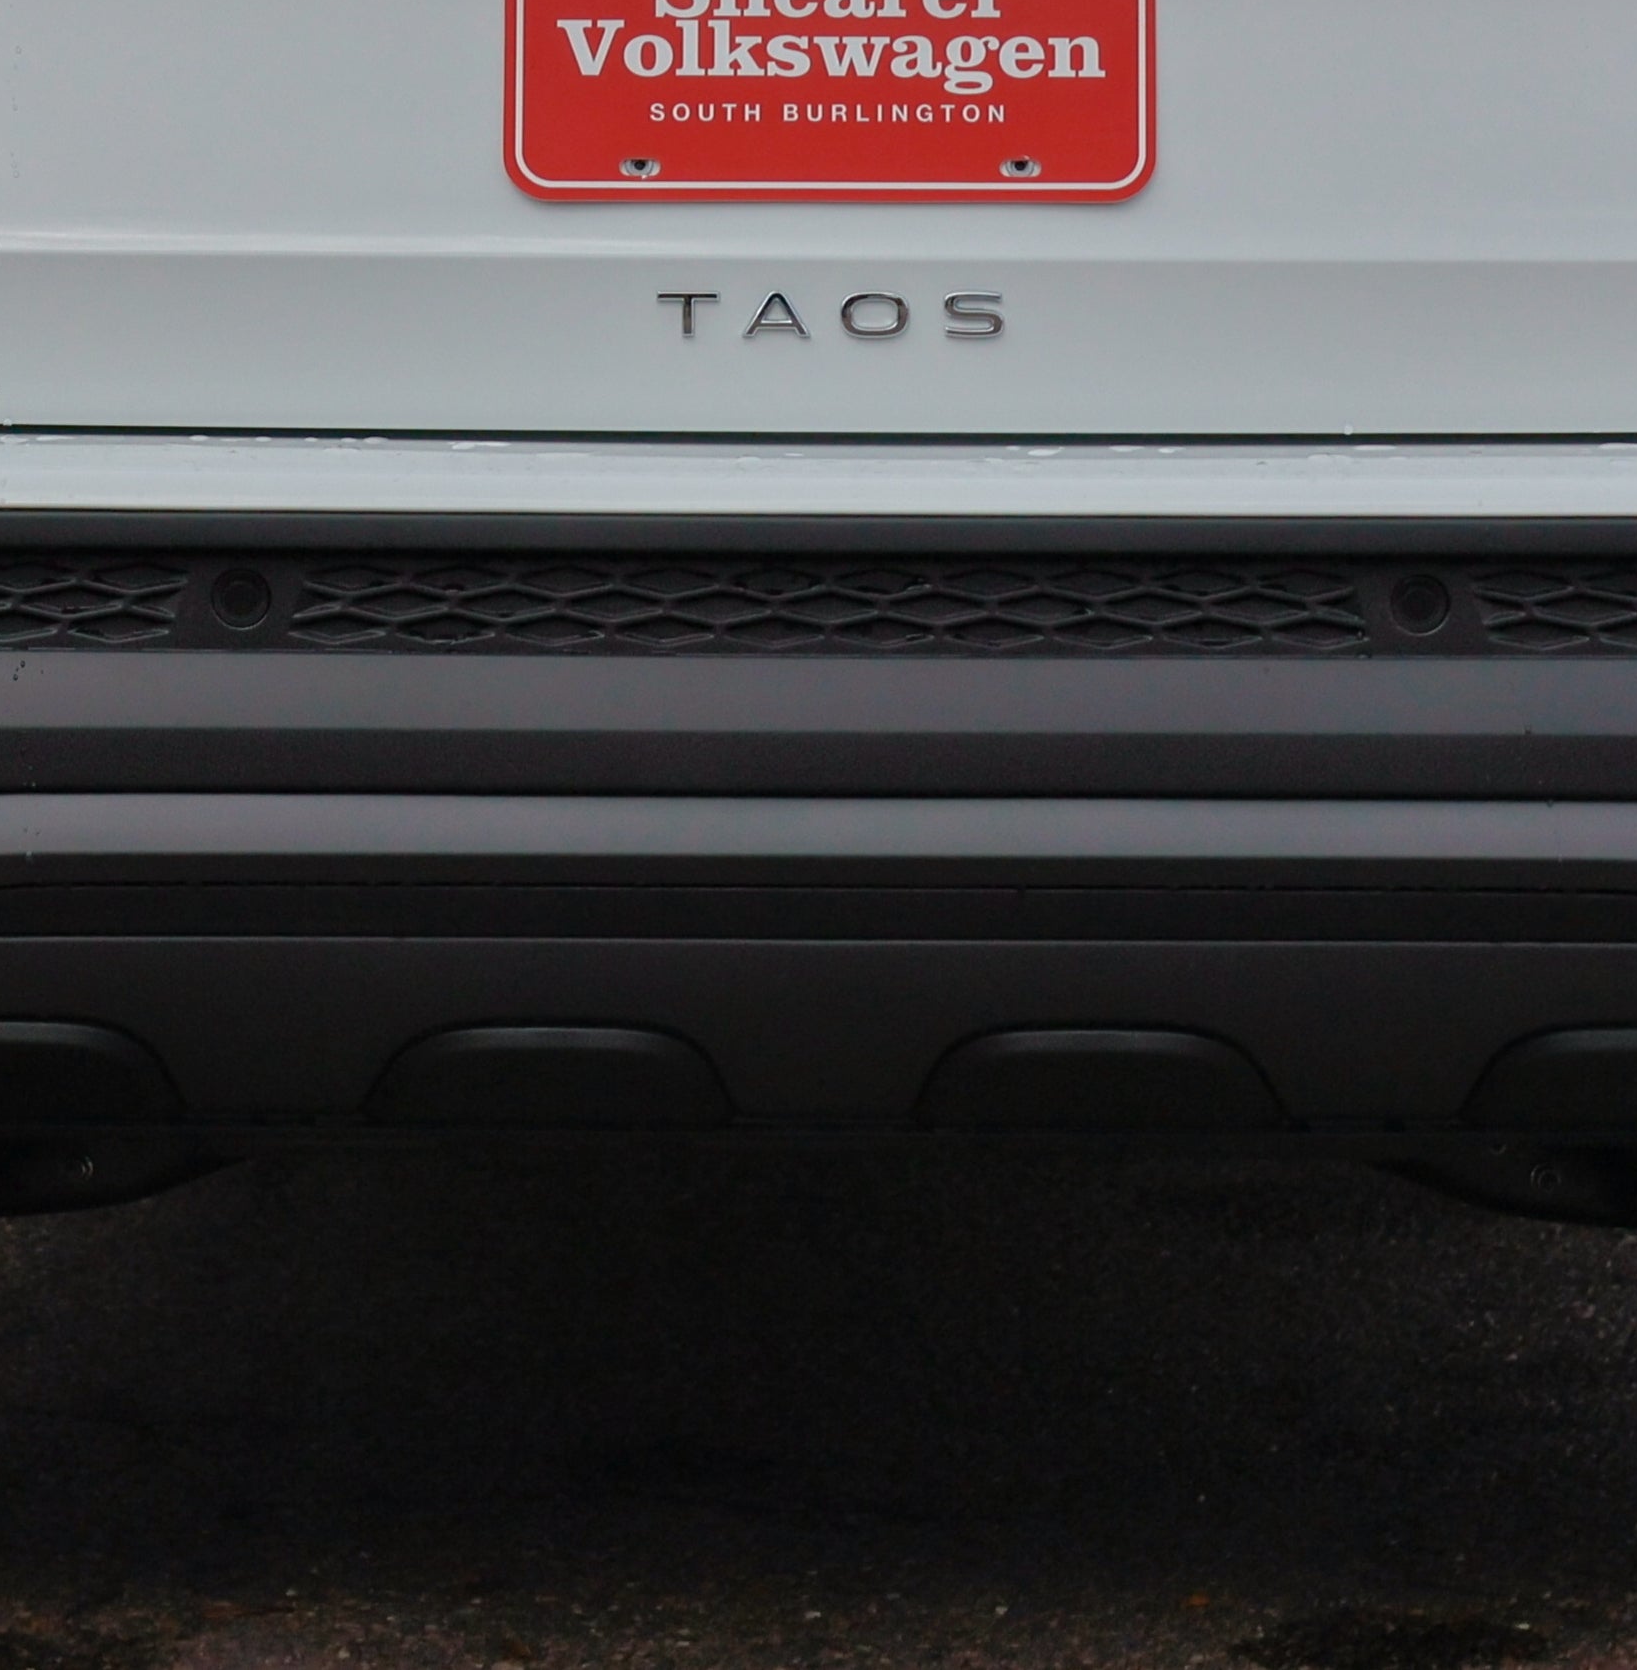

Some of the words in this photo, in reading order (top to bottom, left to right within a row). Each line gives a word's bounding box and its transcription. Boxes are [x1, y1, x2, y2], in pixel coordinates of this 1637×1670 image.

[557, 18, 1107, 95] Volkswagen
[649, 102, 762, 123] SOUTH
[782, 102, 1007, 124] BURLINGTON
[656, 290, 1005, 339] TAOS
